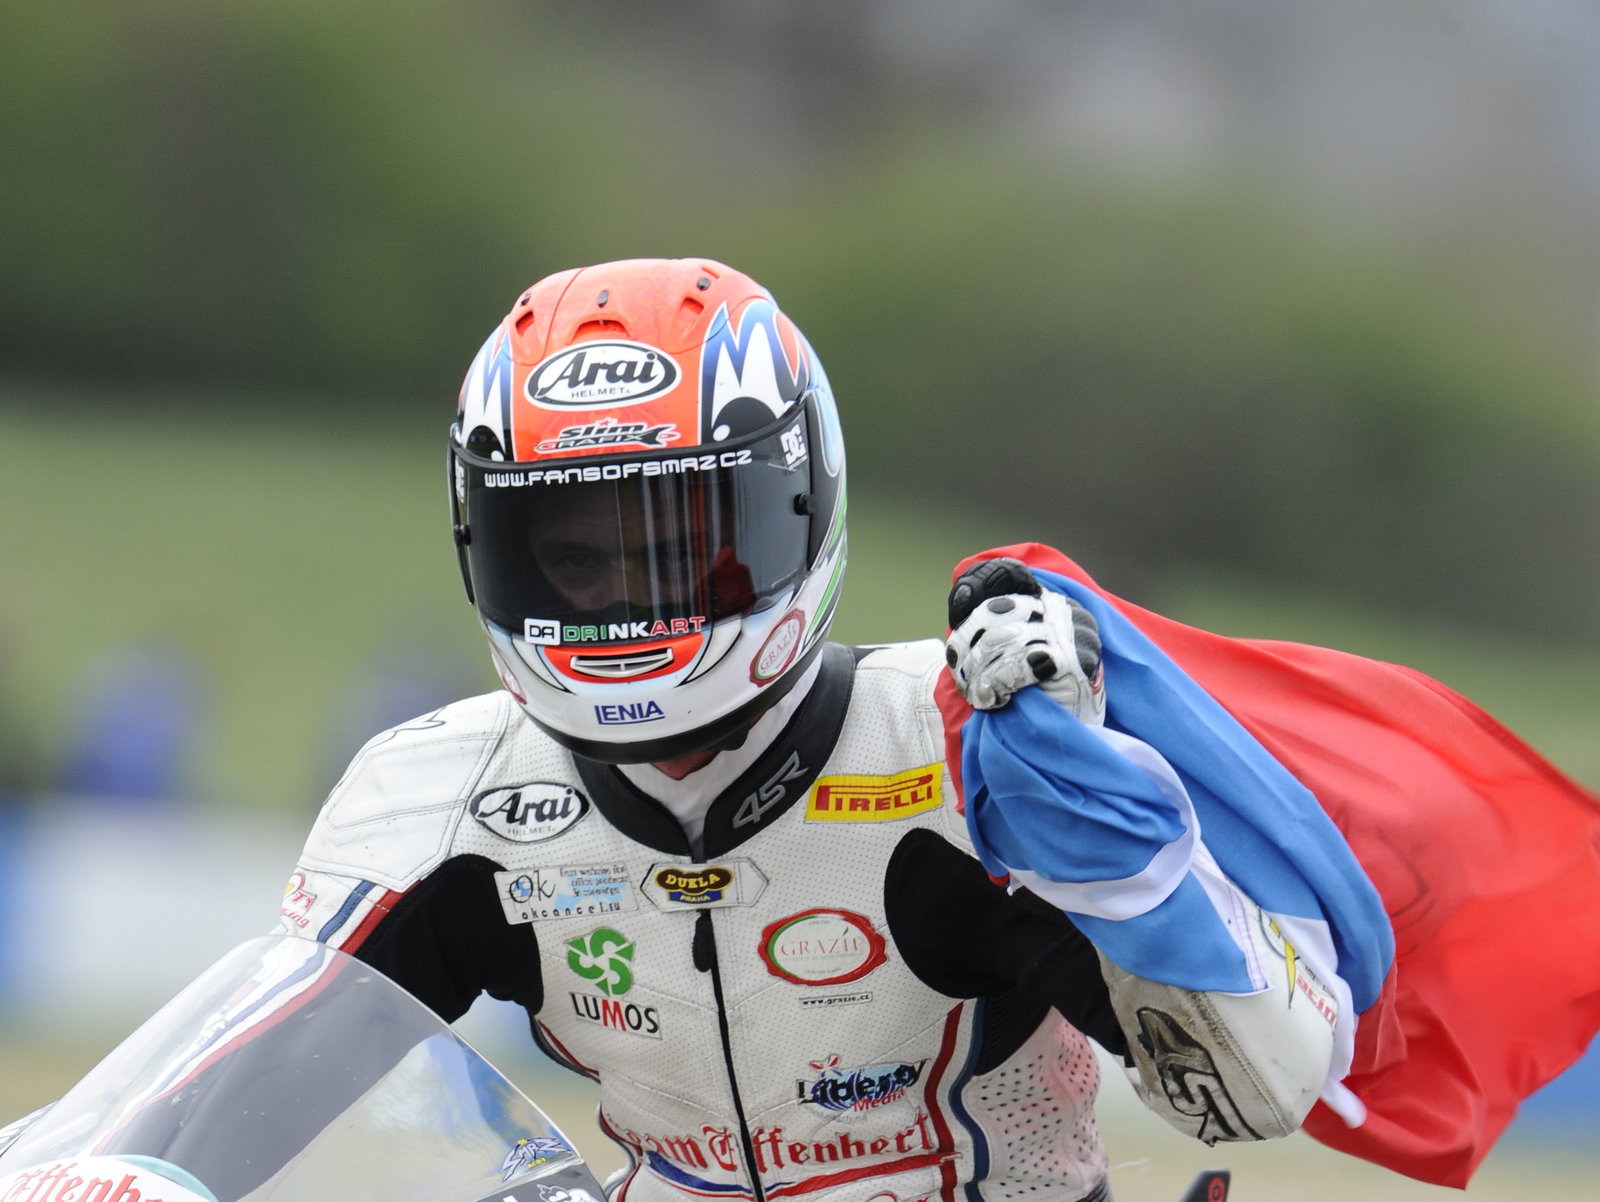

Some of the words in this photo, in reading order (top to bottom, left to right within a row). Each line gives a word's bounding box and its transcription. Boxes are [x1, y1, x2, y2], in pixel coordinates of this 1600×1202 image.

[533, 352, 659, 398] Arai
[571, 387, 624, 399] HELMET
[538, 435, 644, 450] GRAFIX
[563, 616, 706, 642] DRINKART
[814, 773, 934, 812] PIRELLI
[477, 787, 576, 826] Arai
[665, 873, 721, 889] DUKLA
[570, 993, 659, 1035] LUMOS
[853, 1087, 906, 1113] Media
